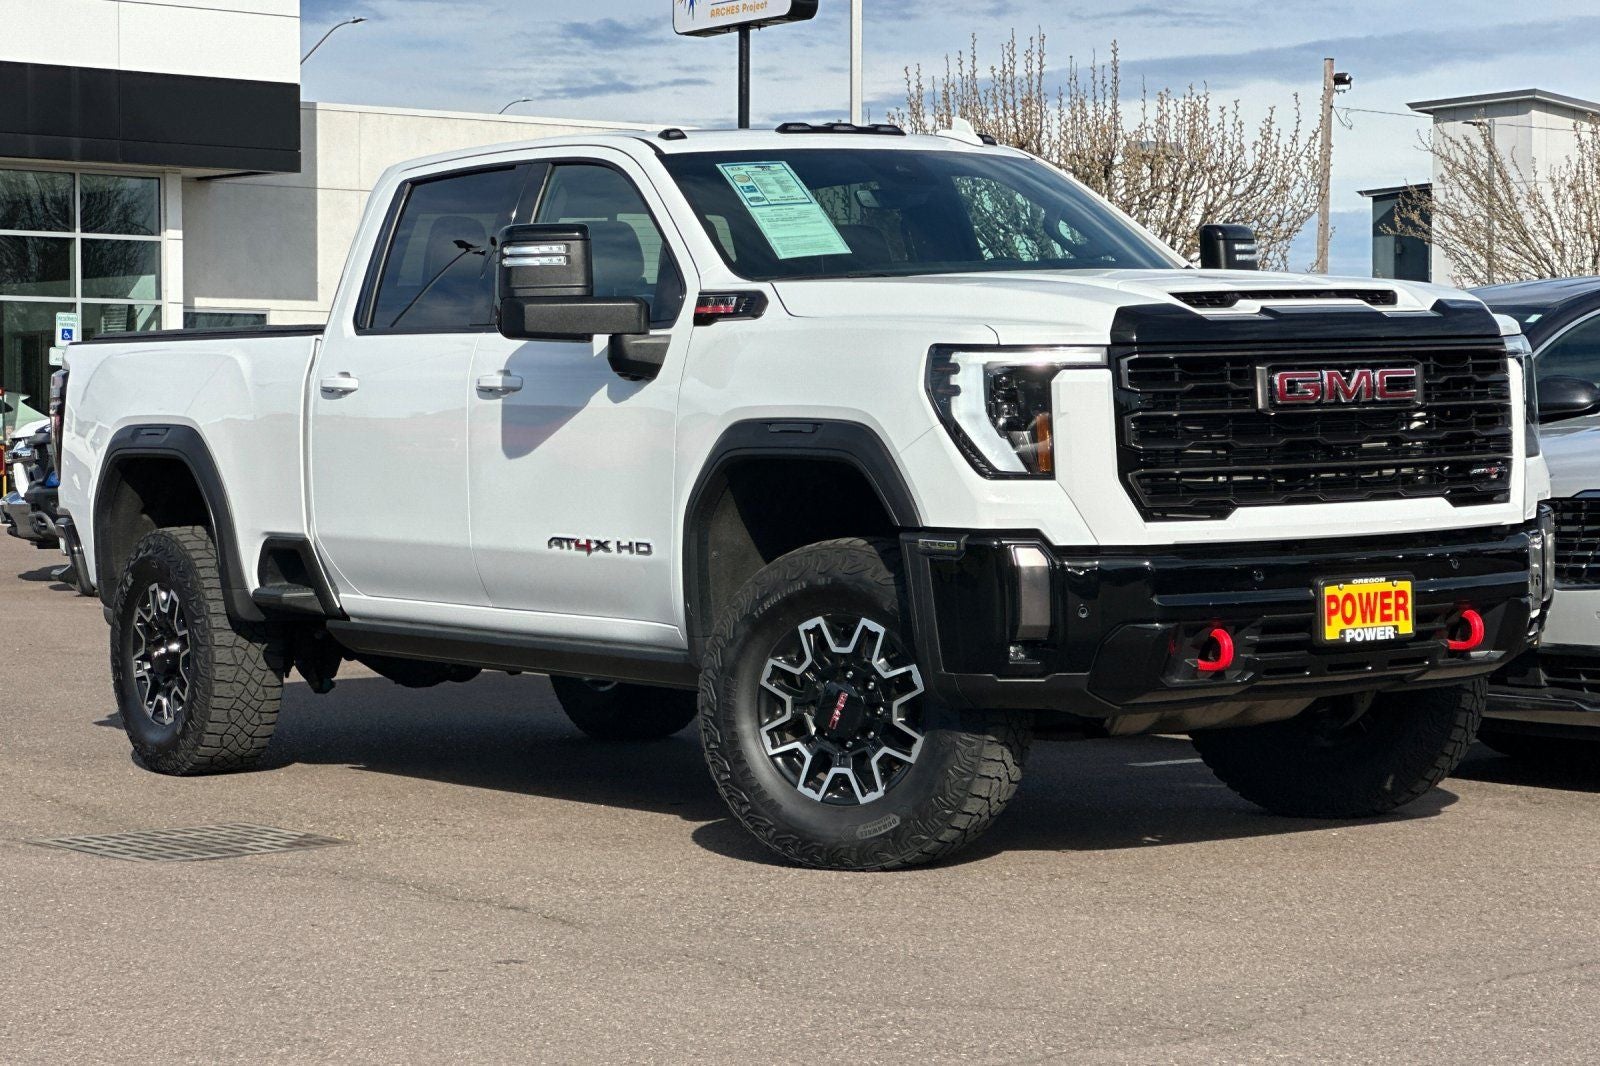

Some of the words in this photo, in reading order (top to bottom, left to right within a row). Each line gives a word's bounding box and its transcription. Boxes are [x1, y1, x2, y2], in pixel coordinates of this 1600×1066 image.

[710, 4, 740, 18] ARCHES
[742, 1, 768, 13] Project
[1275, 368, 1417, 404] GMC
[548, 536, 613, 556] AT4X
[616, 540, 653, 556] HD
[1352, 577, 1386, 585] OREGON
[1326, 590, 1410, 627] POWER
[1345, 626, 1395, 643] POWER
[829, 692, 848, 730] GMC
